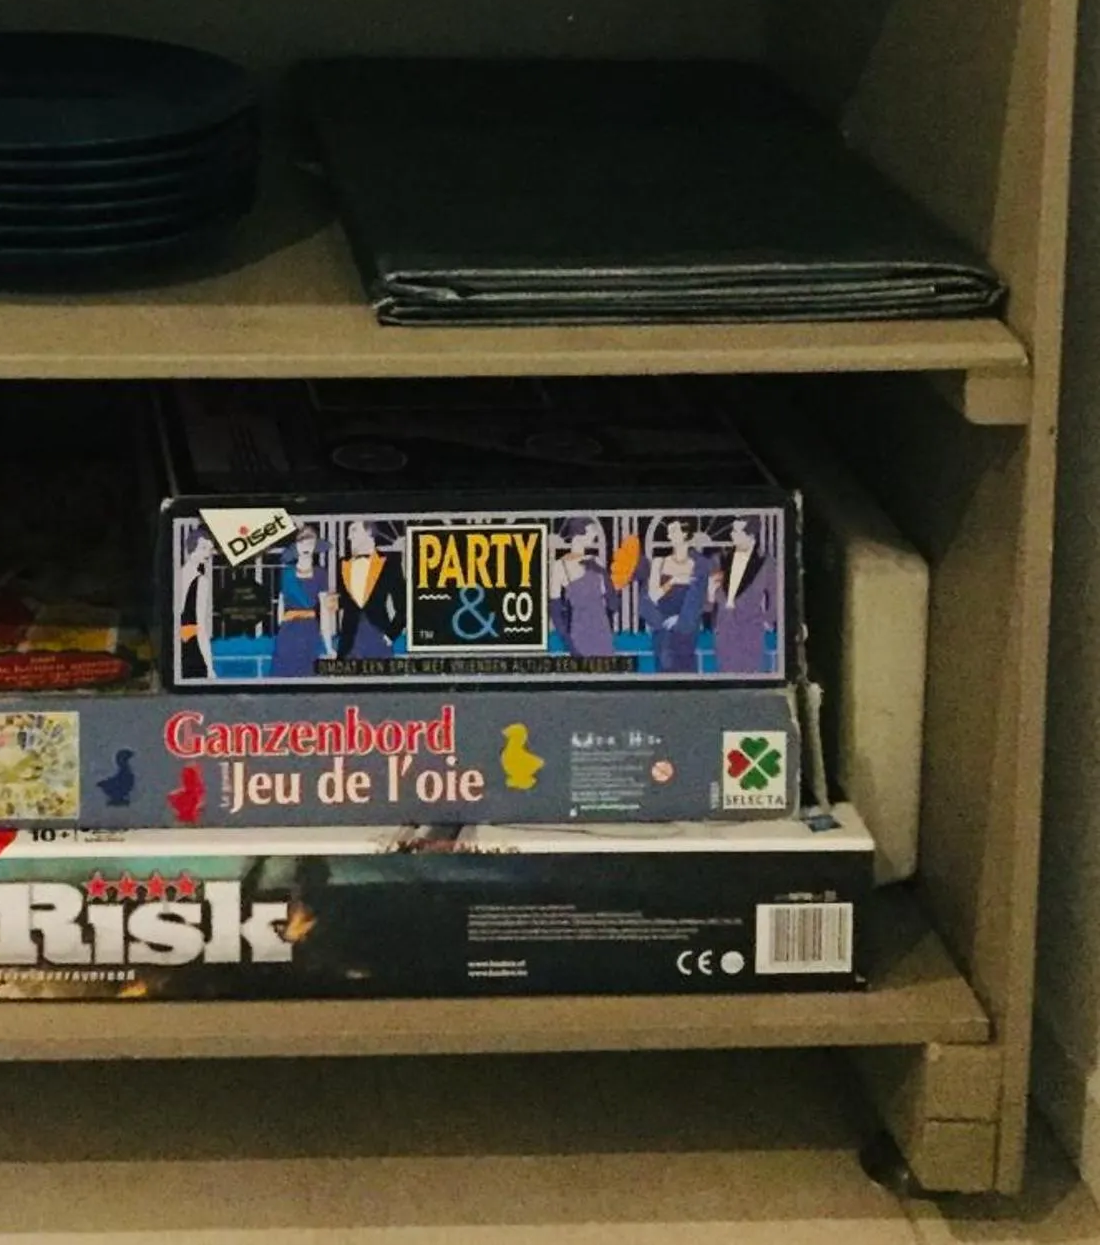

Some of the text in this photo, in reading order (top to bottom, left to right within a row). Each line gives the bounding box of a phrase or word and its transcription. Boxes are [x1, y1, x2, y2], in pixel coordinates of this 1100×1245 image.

[227, 515, 287, 557] Diset
[417, 533, 539, 589] PARTY
[452, 583, 534, 640] & CO
[164, 706, 456, 757] Ganzenbord
[228, 755, 485, 814] Jeu de l'oie
[725, 794, 783, 807] SELECTA
[30, 827, 70, 844] 10+
